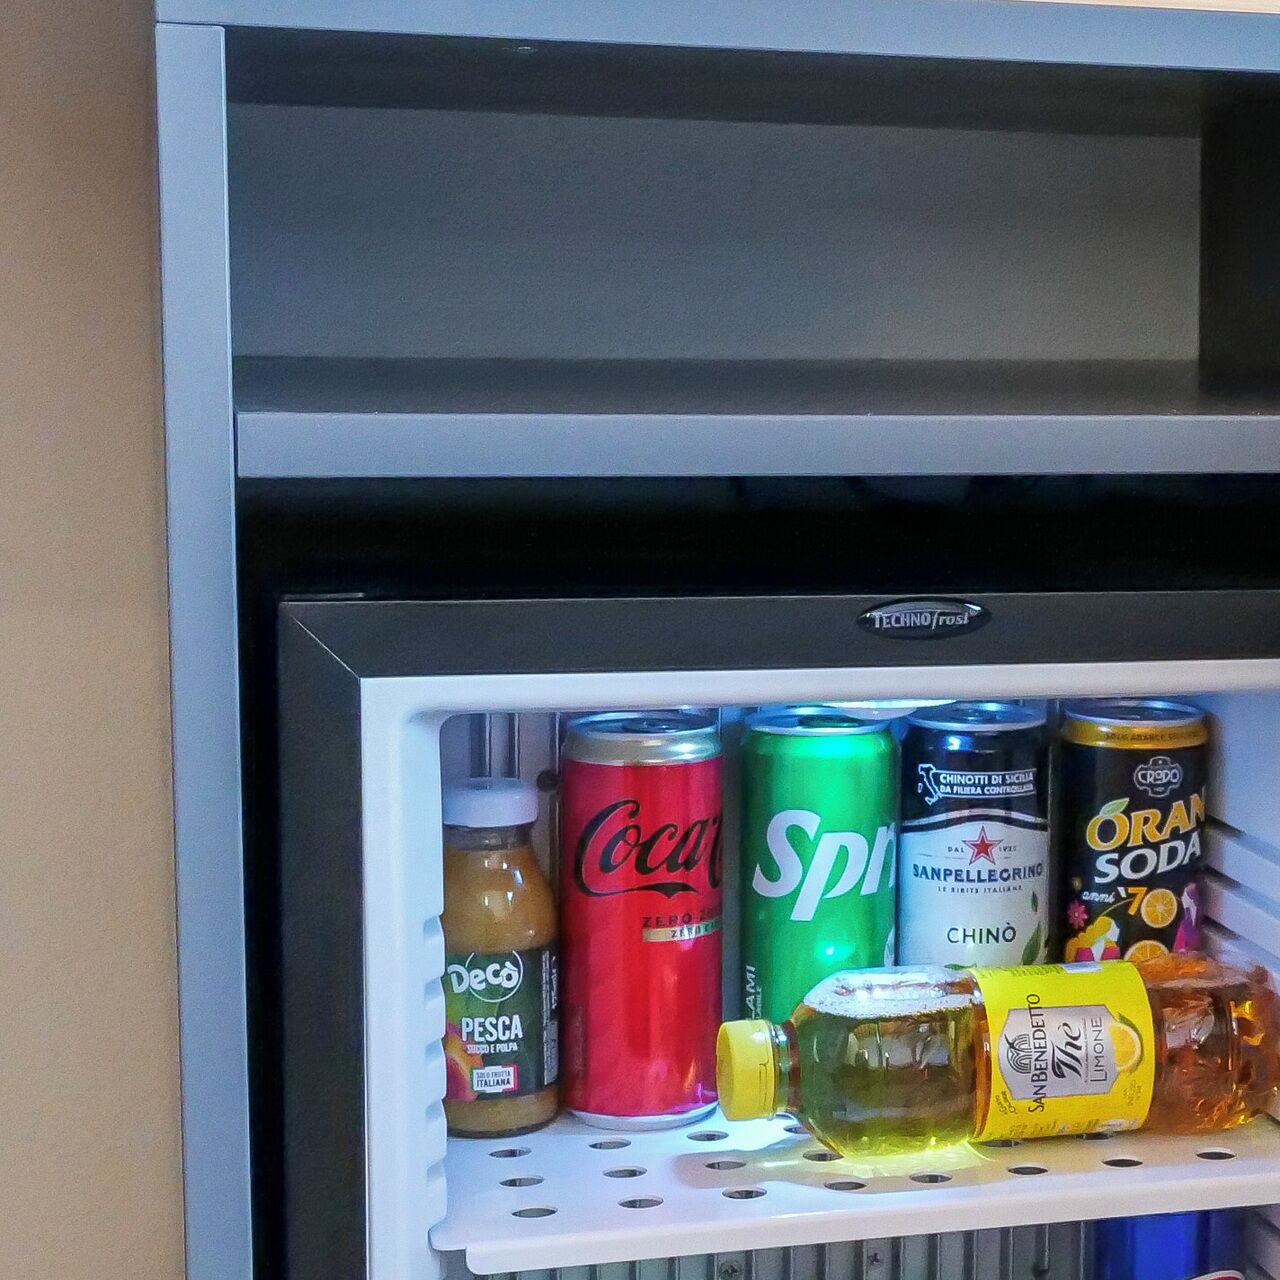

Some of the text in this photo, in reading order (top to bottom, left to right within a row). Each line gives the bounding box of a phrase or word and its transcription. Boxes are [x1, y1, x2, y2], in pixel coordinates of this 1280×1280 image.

[939, 772, 1034, 785] CHINOTTI DI SICILIA
[1137, 769, 1181, 783] CRODO
[940, 785, 951, 794] DA
[953, 785, 982, 795] FILIERA
[1094, 831, 1201, 884] SODA
[912, 862, 1043, 883] SANPELLEGRINO
[641, 913, 693, 929] ZERO
[946, 922, 1017, 945] CHINÒ
[461, 1014, 523, 1042] PESCA
[466, 1042, 518, 1054] SUCCO E POLPA
[1090, 1016, 1108, 1082] LIMONE
[476, 1077, 511, 1088] ITALIANA
